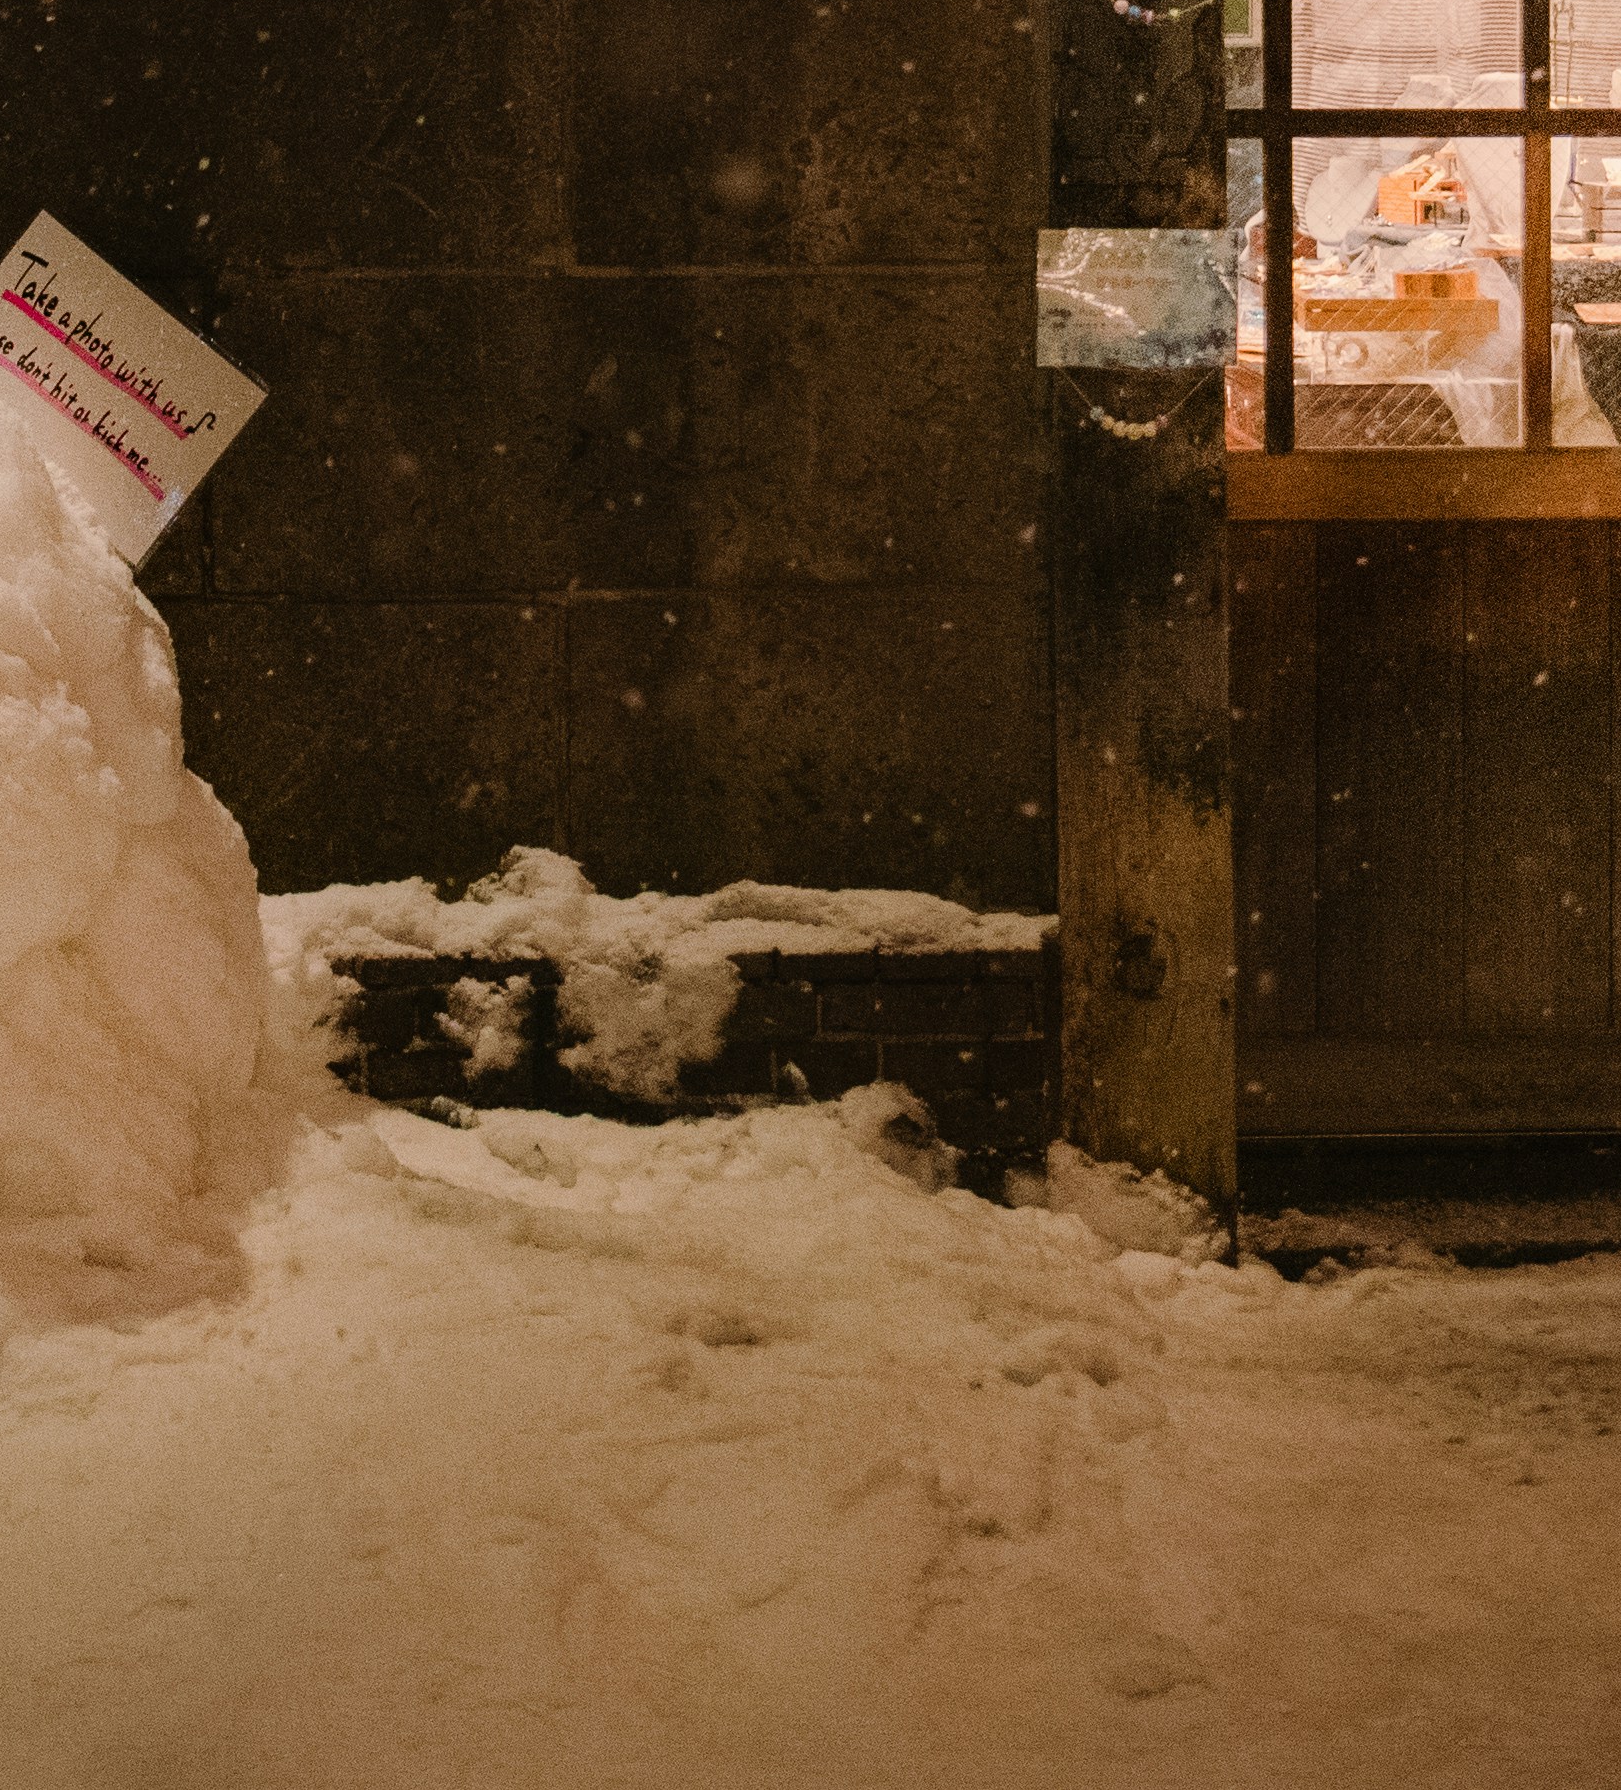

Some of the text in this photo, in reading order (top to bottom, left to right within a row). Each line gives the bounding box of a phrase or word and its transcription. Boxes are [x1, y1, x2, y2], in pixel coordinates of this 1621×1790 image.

[13, 250, 188, 424] Take a photo with us
[17, 347, 52, 386] don't
[49, 373, 78, 409] hit
[74, 407, 91, 423] or
[92, 412, 128, 453] kick
